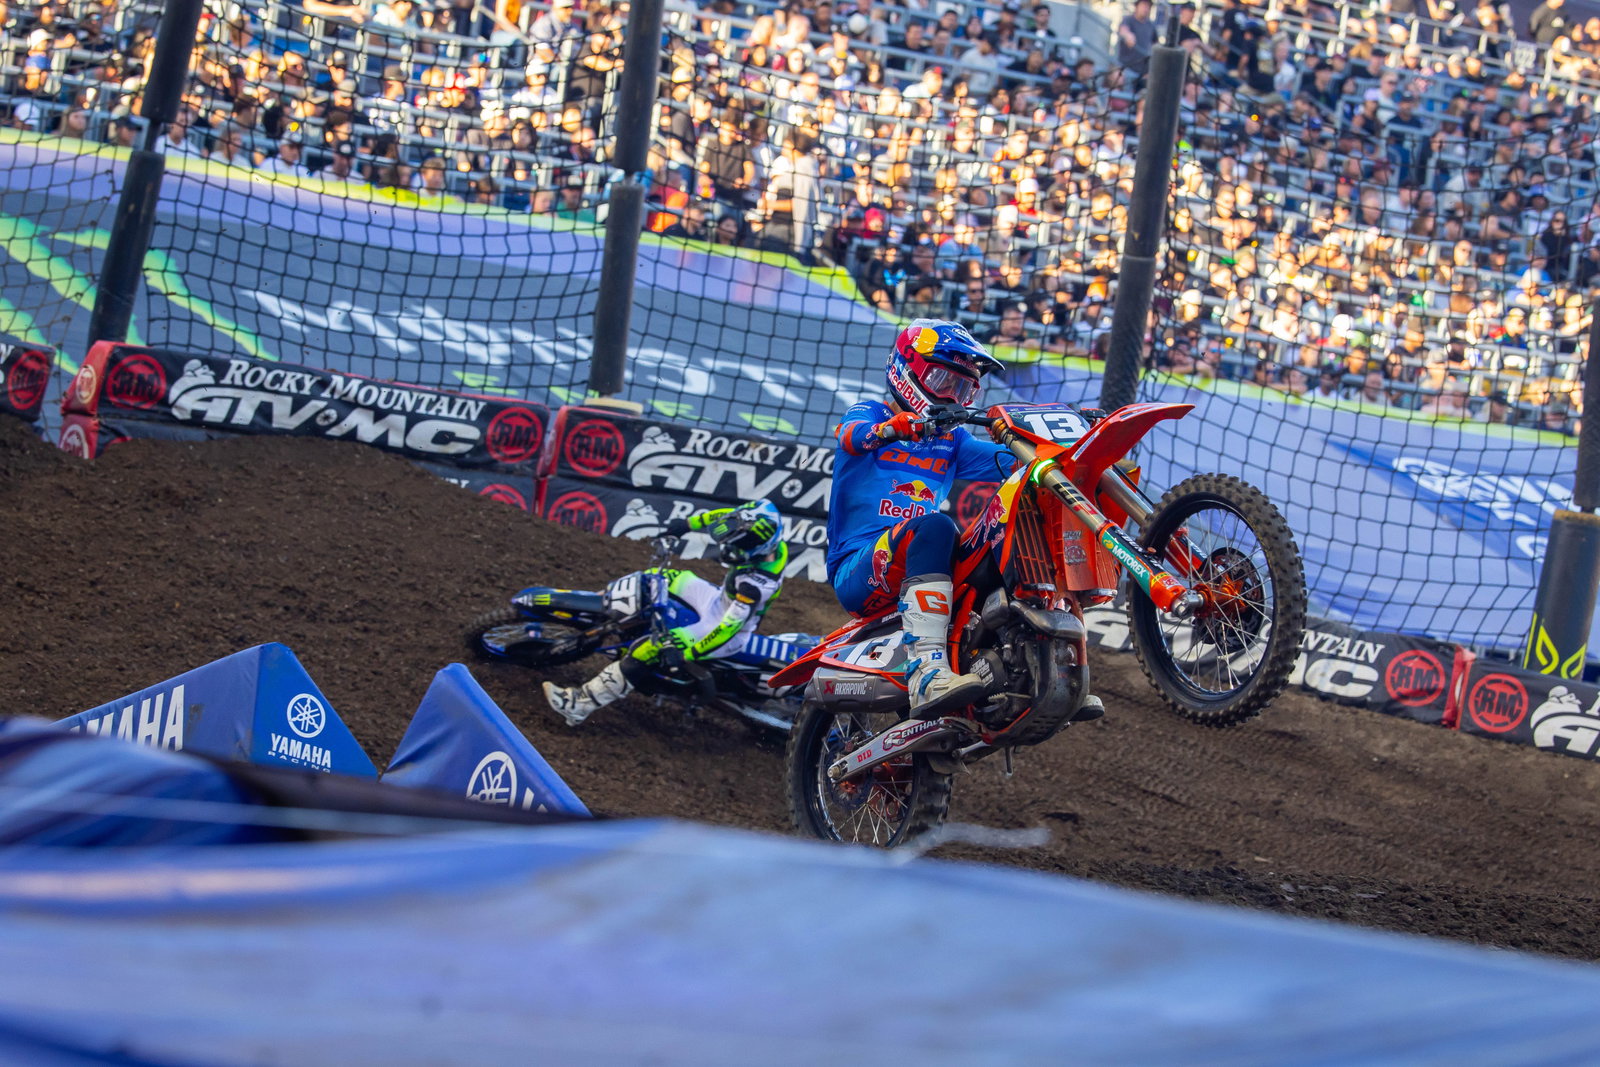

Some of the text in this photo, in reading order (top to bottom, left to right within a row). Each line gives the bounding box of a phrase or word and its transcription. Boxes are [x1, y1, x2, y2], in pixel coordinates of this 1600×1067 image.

[219, 359, 487, 422] ROCKY MOUNTAIN
[1023, 412, 1089, 441] 13
[680, 428, 787, 466] ROCKY
[879, 499, 914, 519] Red
[1111, 544, 1147, 578] MOTOREX
[844, 630, 904, 669] 13
[931, 652, 943, 661] 13
[267, 750, 331, 774] RACING
[271, 733, 332, 769] YAMAHA
[857, 749, 873, 763] DID
